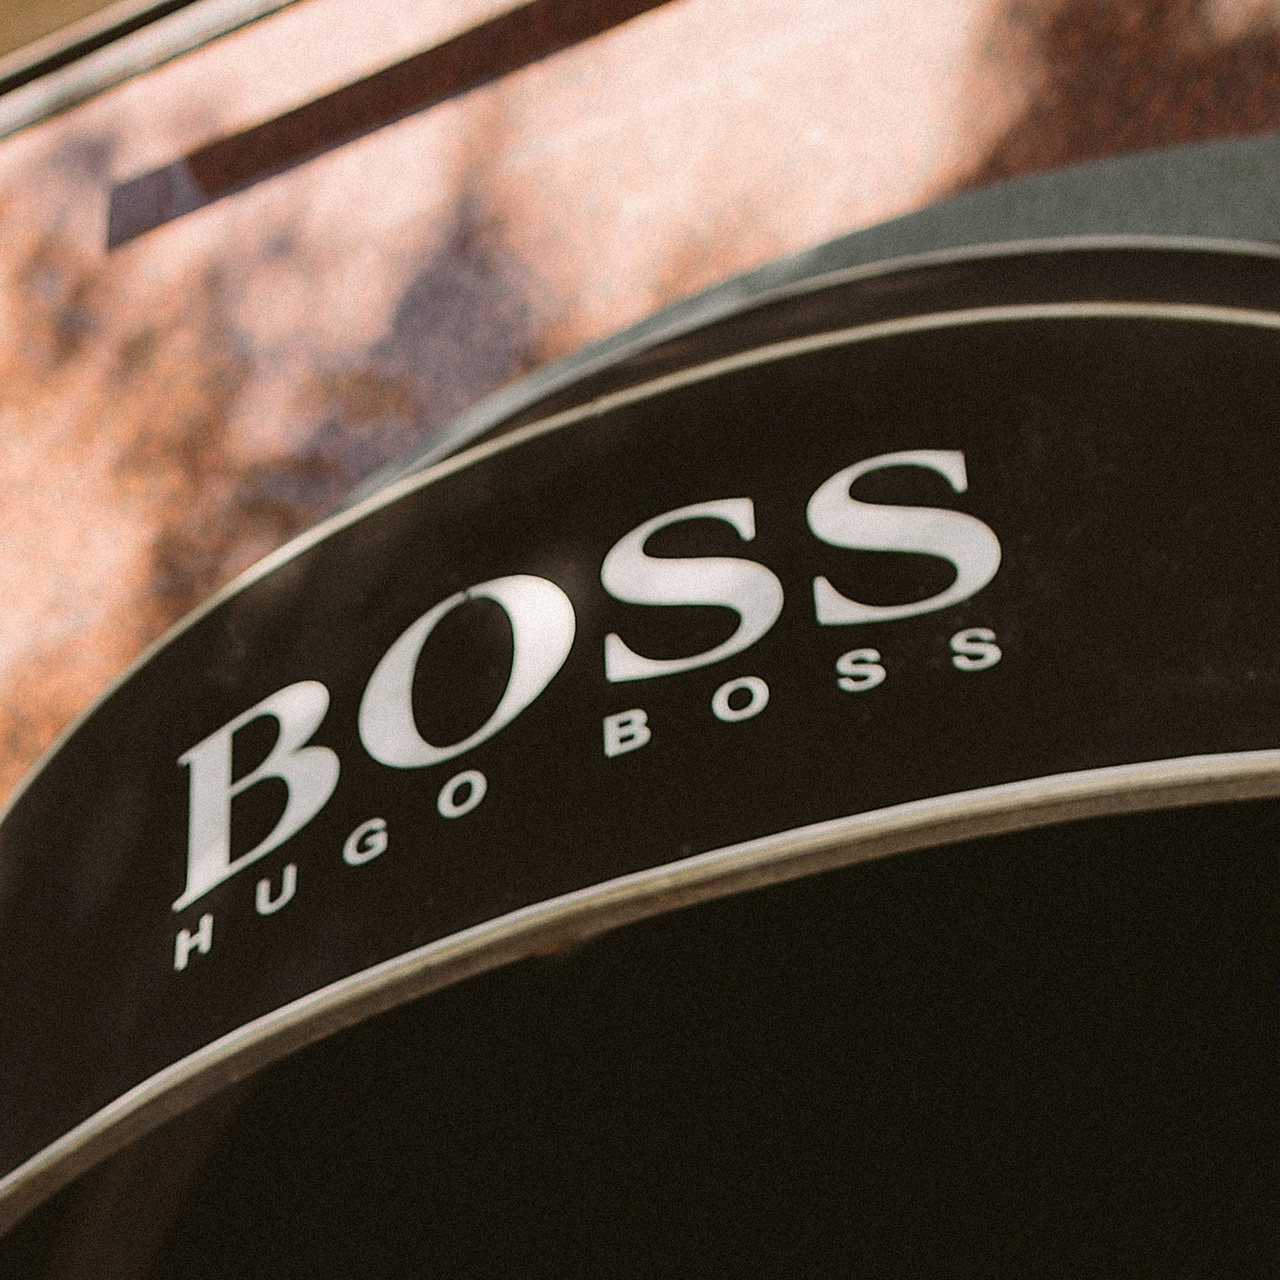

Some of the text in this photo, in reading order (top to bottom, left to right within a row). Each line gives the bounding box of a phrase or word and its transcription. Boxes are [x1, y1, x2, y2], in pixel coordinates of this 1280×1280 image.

[172, 449, 1002, 913] BOSS
[174, 628, 1002, 970] HUGO BOSS
